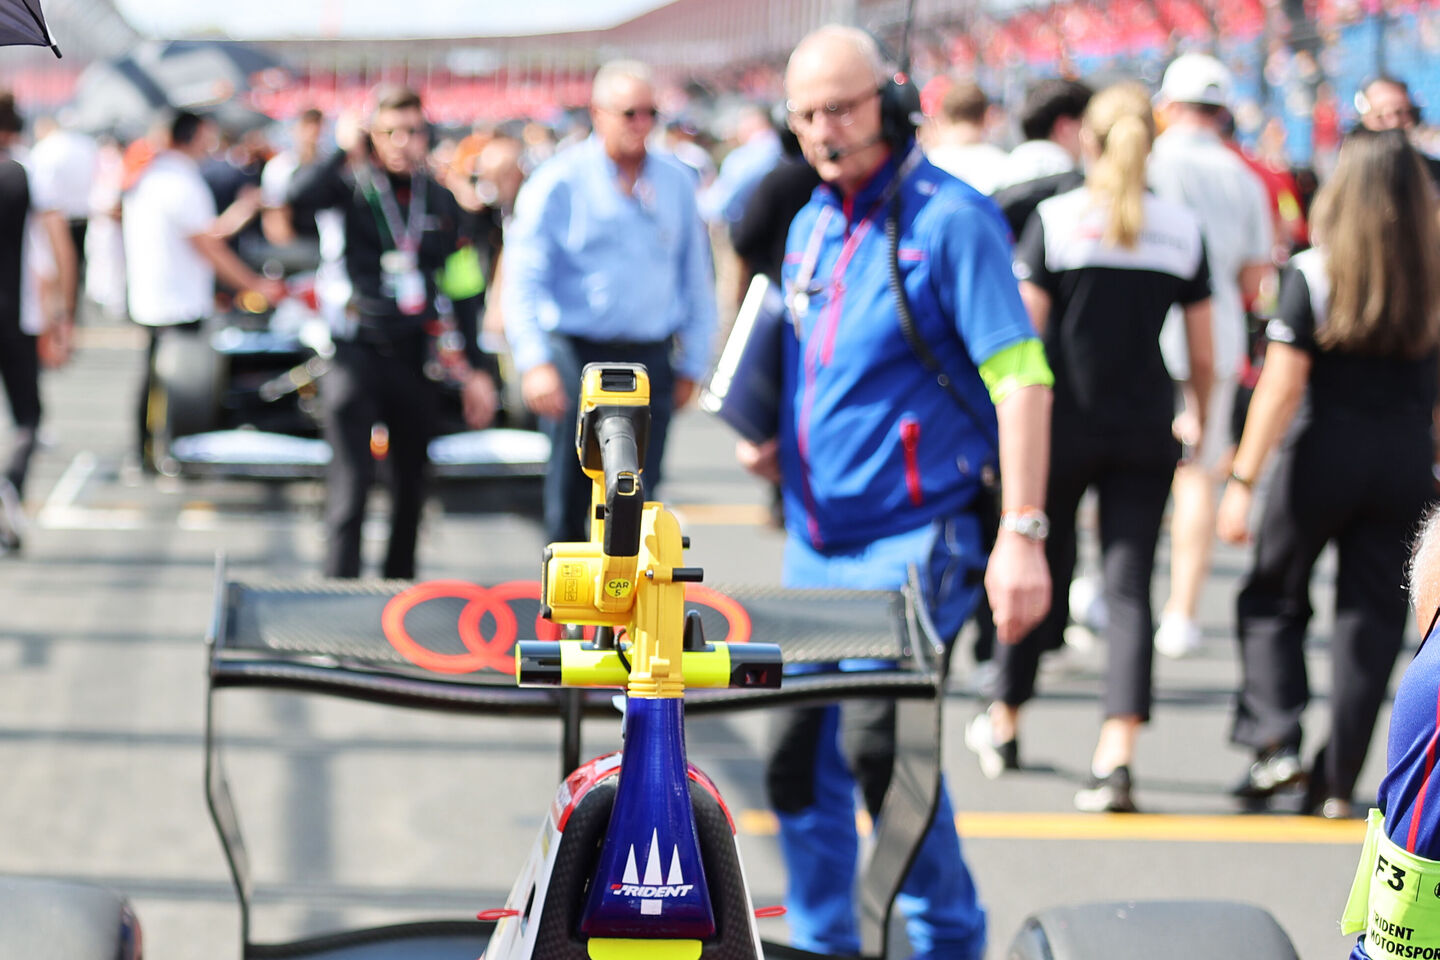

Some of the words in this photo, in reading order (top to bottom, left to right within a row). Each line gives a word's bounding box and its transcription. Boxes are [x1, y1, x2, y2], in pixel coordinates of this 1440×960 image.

[608, 581, 629, 590] CAR
[614, 588, 622, 597] 5
[1375, 854, 1407, 892] F3
[610, 883, 694, 898] TRIDENT
[1374, 911, 1414, 941] RIDENT
